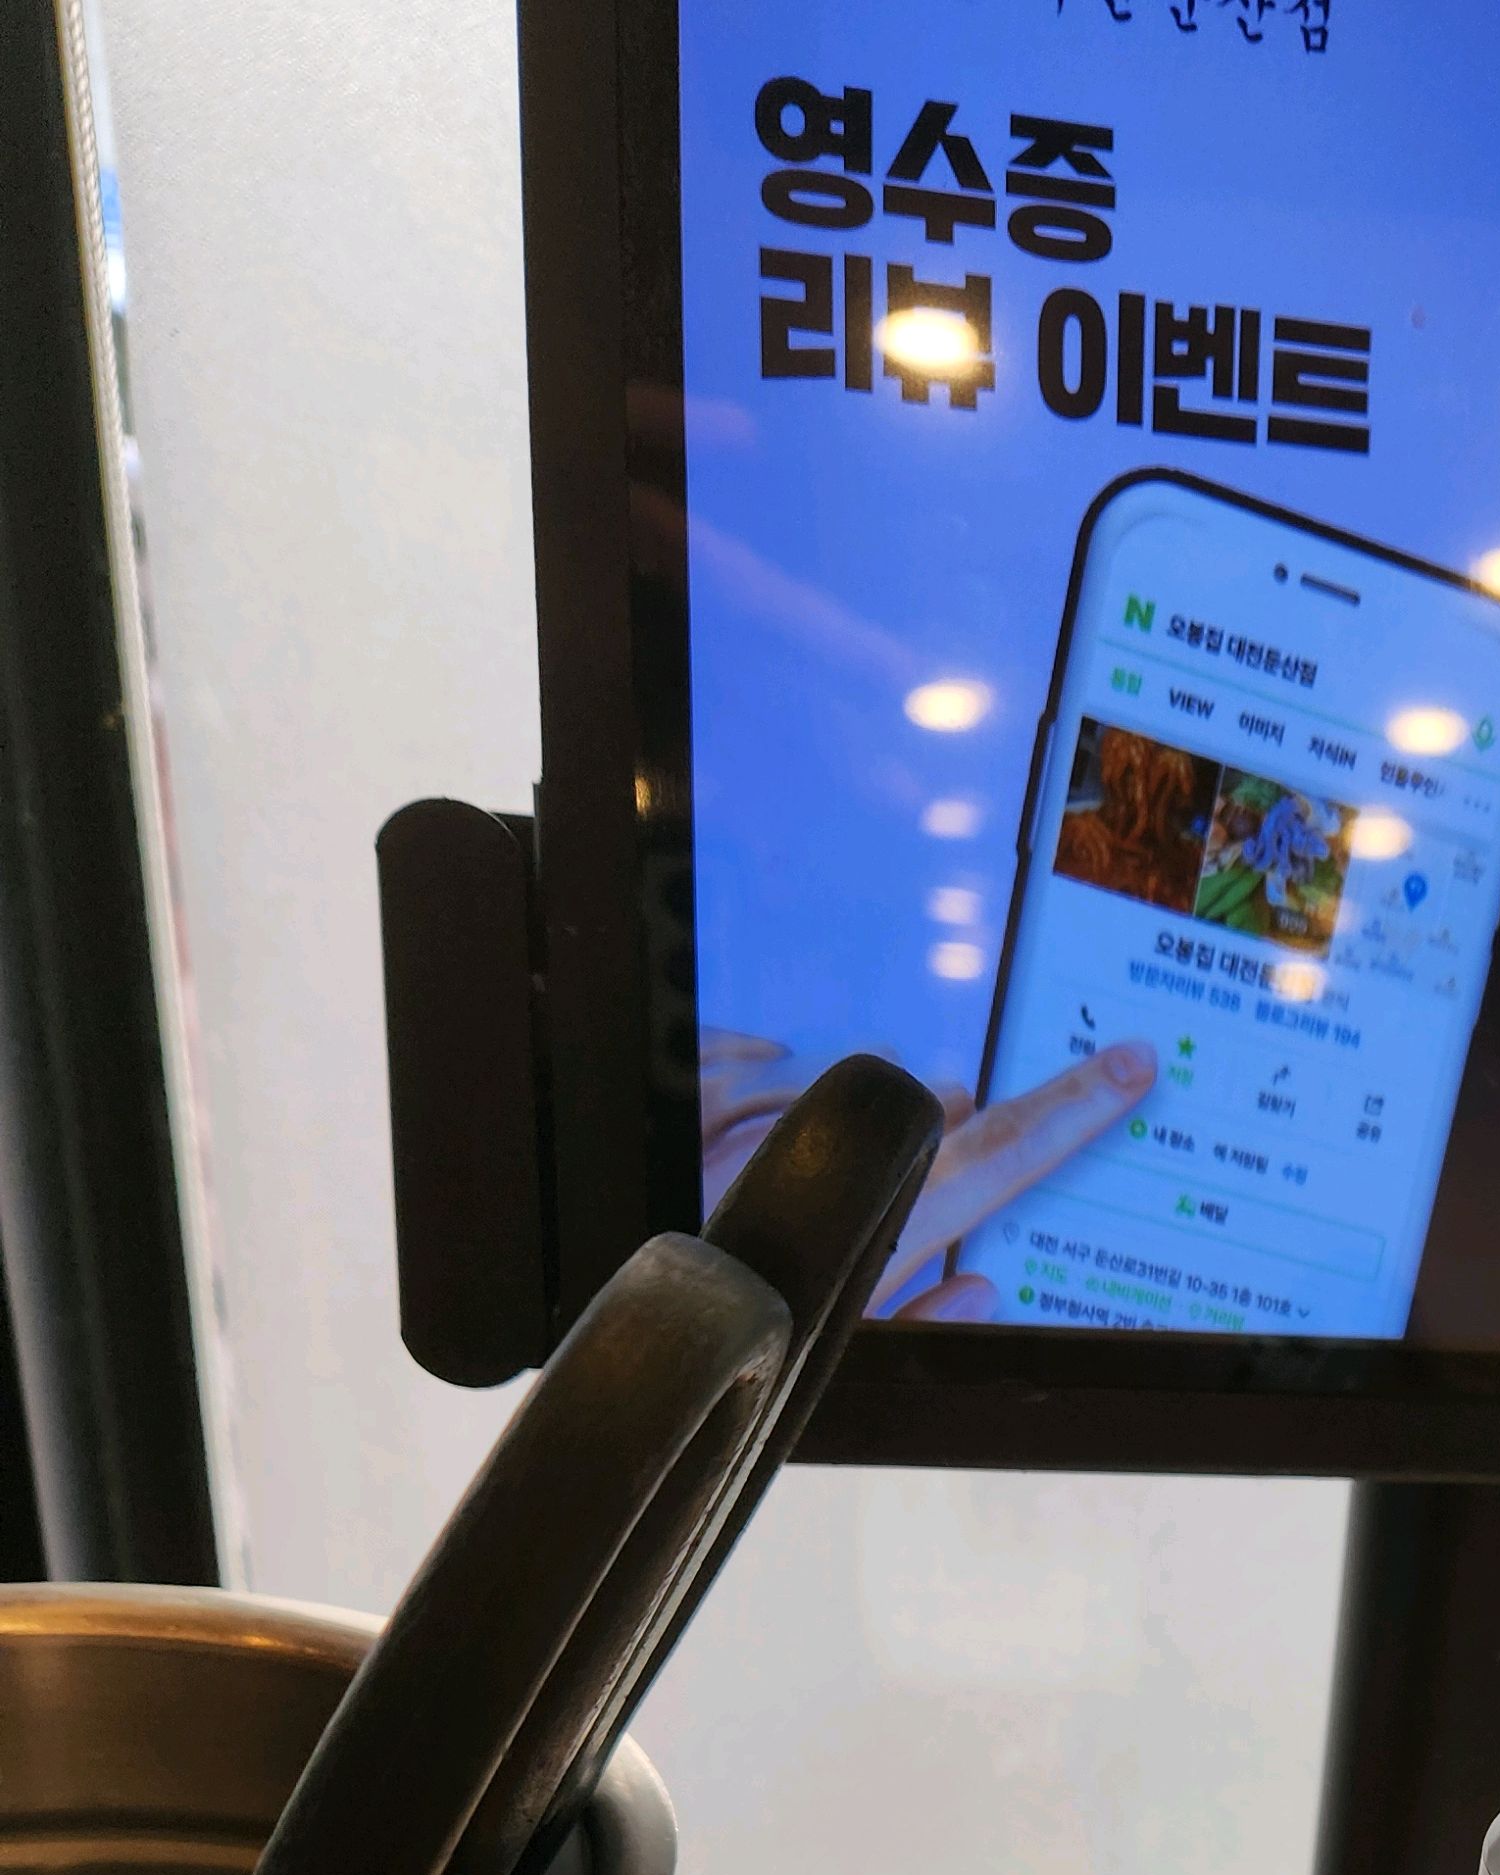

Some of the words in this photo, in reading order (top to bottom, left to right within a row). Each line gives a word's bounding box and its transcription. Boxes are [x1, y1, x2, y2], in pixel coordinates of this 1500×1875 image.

[754, 75, 1116, 263] 영수증
[759, 246, 997, 411] 리뷰
[1037, 287, 1372, 455] 이벤트
[1123, 593, 1157, 634] N
[1169, 687, 1216, 721] VIEW
[1238, 710, 1287, 748] 이미지
